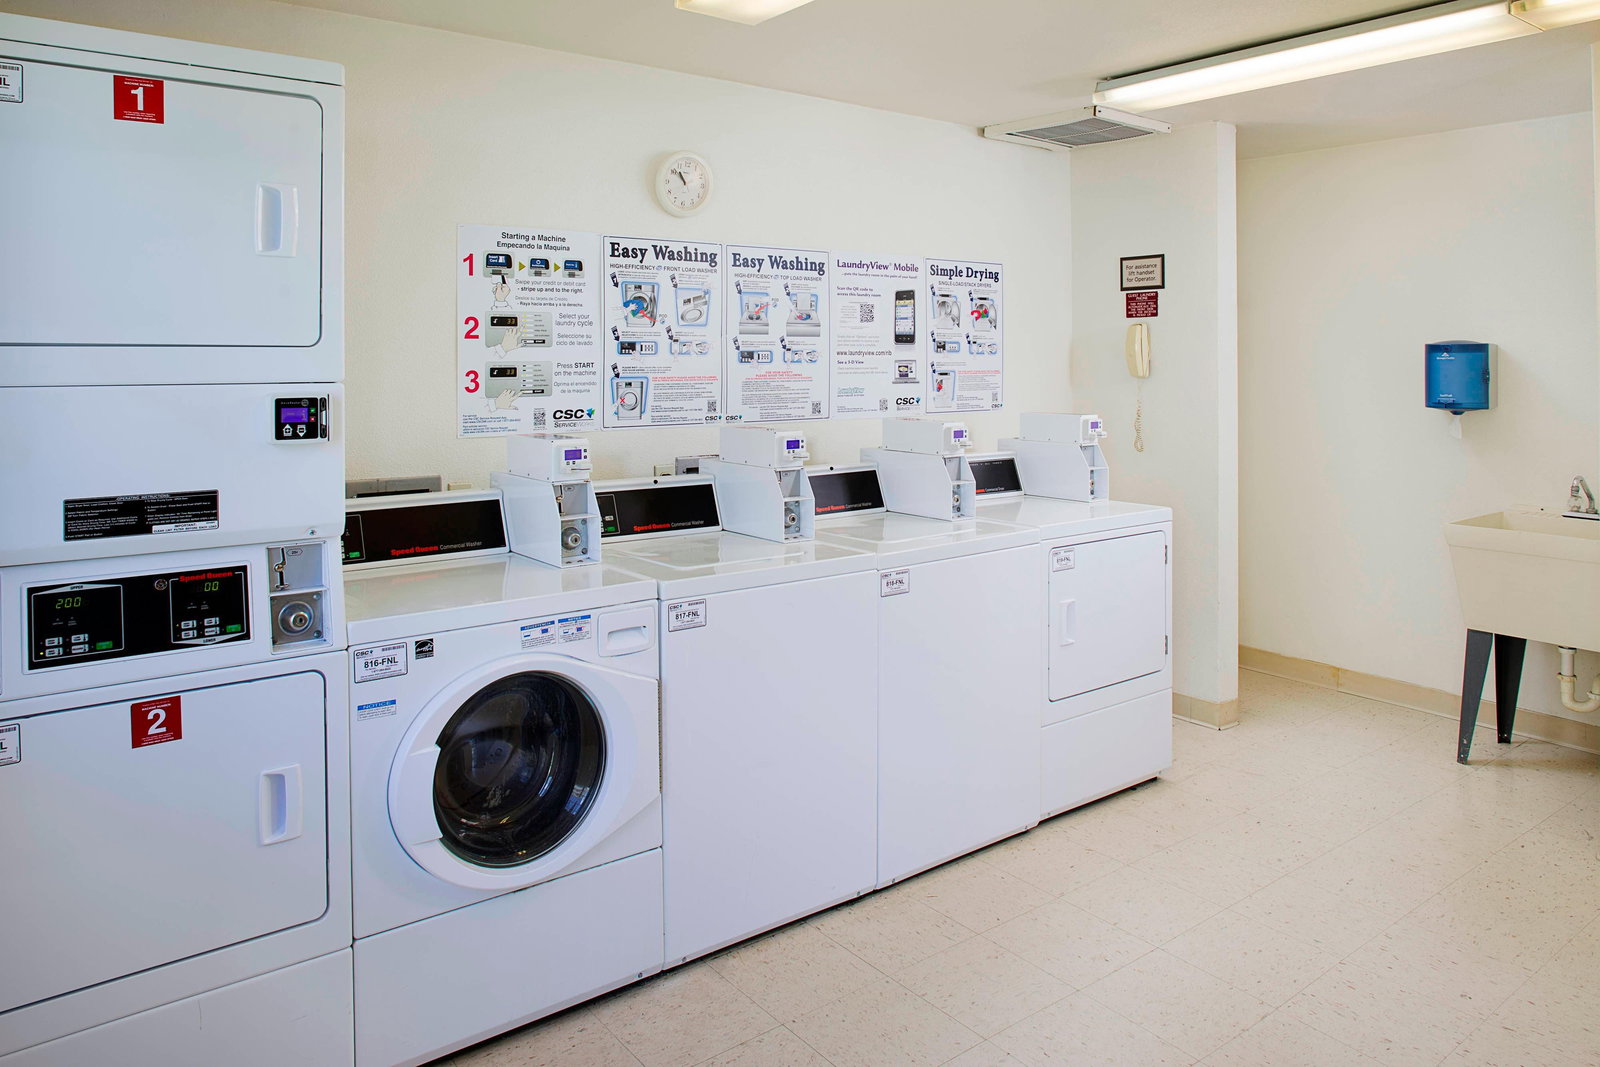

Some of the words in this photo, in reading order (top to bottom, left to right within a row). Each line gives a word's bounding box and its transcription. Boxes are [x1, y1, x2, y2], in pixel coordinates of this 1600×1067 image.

[131, 87, 143, 110] 1
[501, 232, 530, 242] Starting
[538, 234, 567, 243] Machine
[496, 241, 535, 249] Empecando
[610, 242, 648, 264] Easy
[652, 245, 718, 268] Washing
[463, 253, 474, 276] 1
[732, 253, 764, 273] Easy
[768, 255, 825, 276] Washing
[894, 263, 919, 272] Mobile
[930, 265, 963, 280] Simple
[966, 267, 999, 283] Drying
[464, 316, 480, 339] 2
[464, 370, 480, 393] 3
[553, 409, 585, 420] CSC
[633, 523, 651, 531] Speed
[390, 547, 414, 556] Speed
[180, 573, 205, 582] Speed
[204, 581, 219, 591] 00
[56, 597, 81, 609] 200
[676, 611, 700, 620] 817-FNL
[364, 657, 398, 668] 816-FNL
[148, 709, 166, 735] 2
